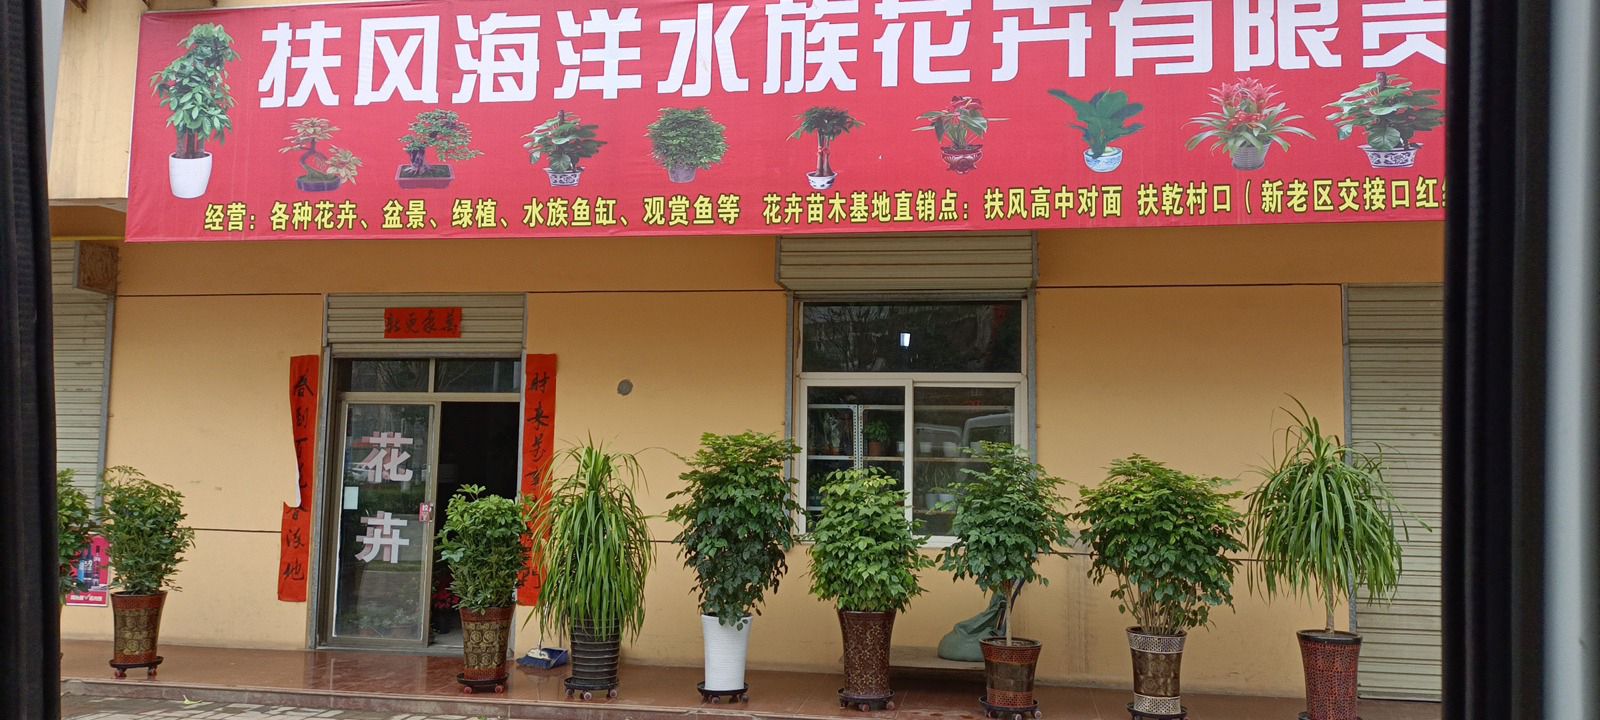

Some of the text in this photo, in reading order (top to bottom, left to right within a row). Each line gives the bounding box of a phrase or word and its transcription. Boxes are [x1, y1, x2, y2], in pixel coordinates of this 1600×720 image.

[1137, 175, 1446, 217] 扶乾村口（新老区交接口红
